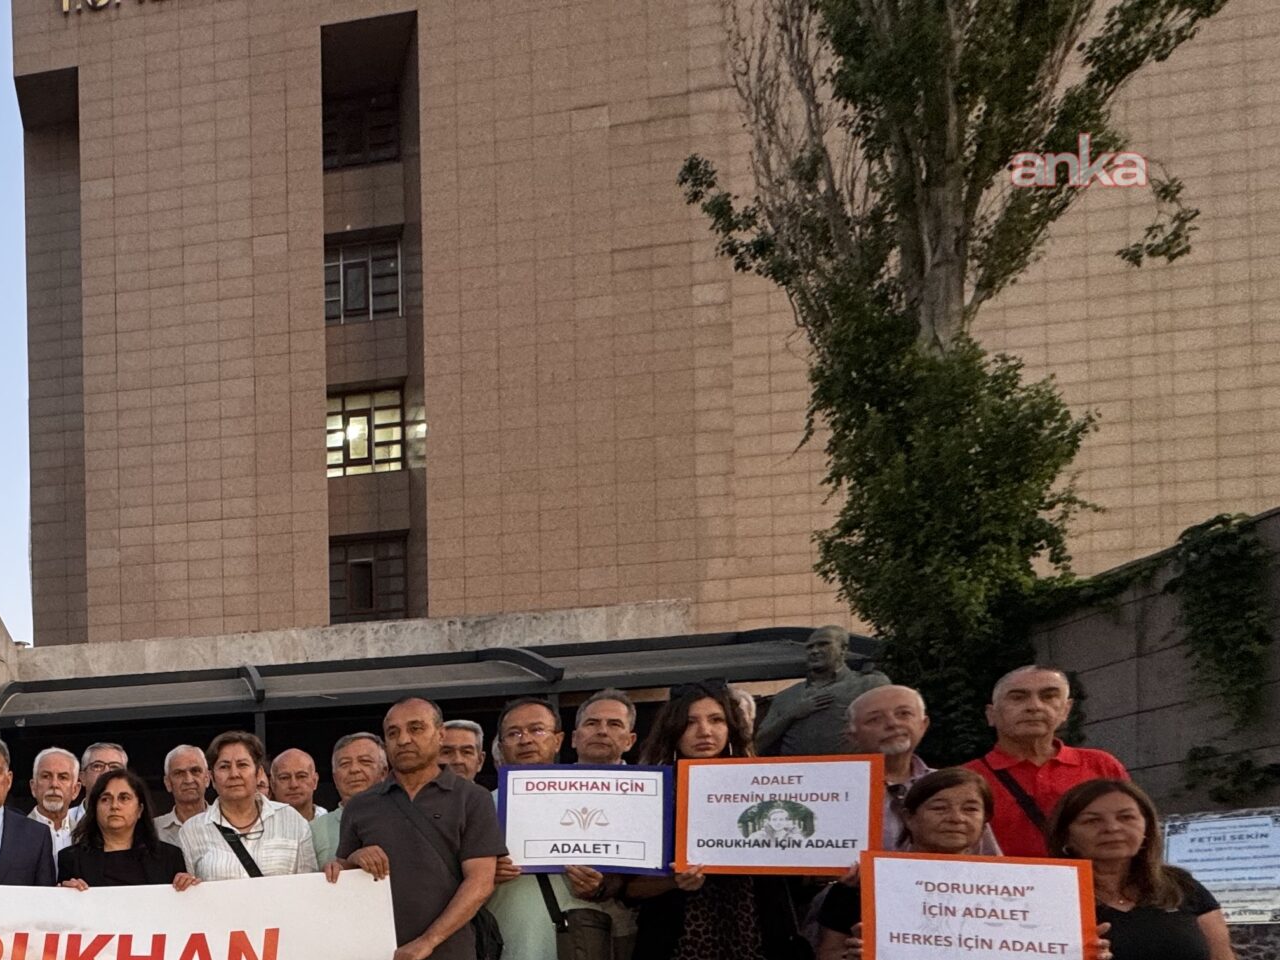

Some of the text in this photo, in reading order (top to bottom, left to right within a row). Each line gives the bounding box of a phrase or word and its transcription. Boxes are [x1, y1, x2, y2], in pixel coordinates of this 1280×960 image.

[750, 775, 804, 785] ADALET
[525, 780, 645, 795] DORUKHAN İÇİN
[707, 791, 765, 803] EVRENİN
[769, 792, 840, 803] RUHUDUR
[549, 843, 611, 854] ADALET
[696, 837, 858, 850] DORUKHAN İÇİN ADALET
[922, 902, 1030, 921] İÇİN ADALET
[889, 932, 1069, 954] HERKES İÇİN ADALET
